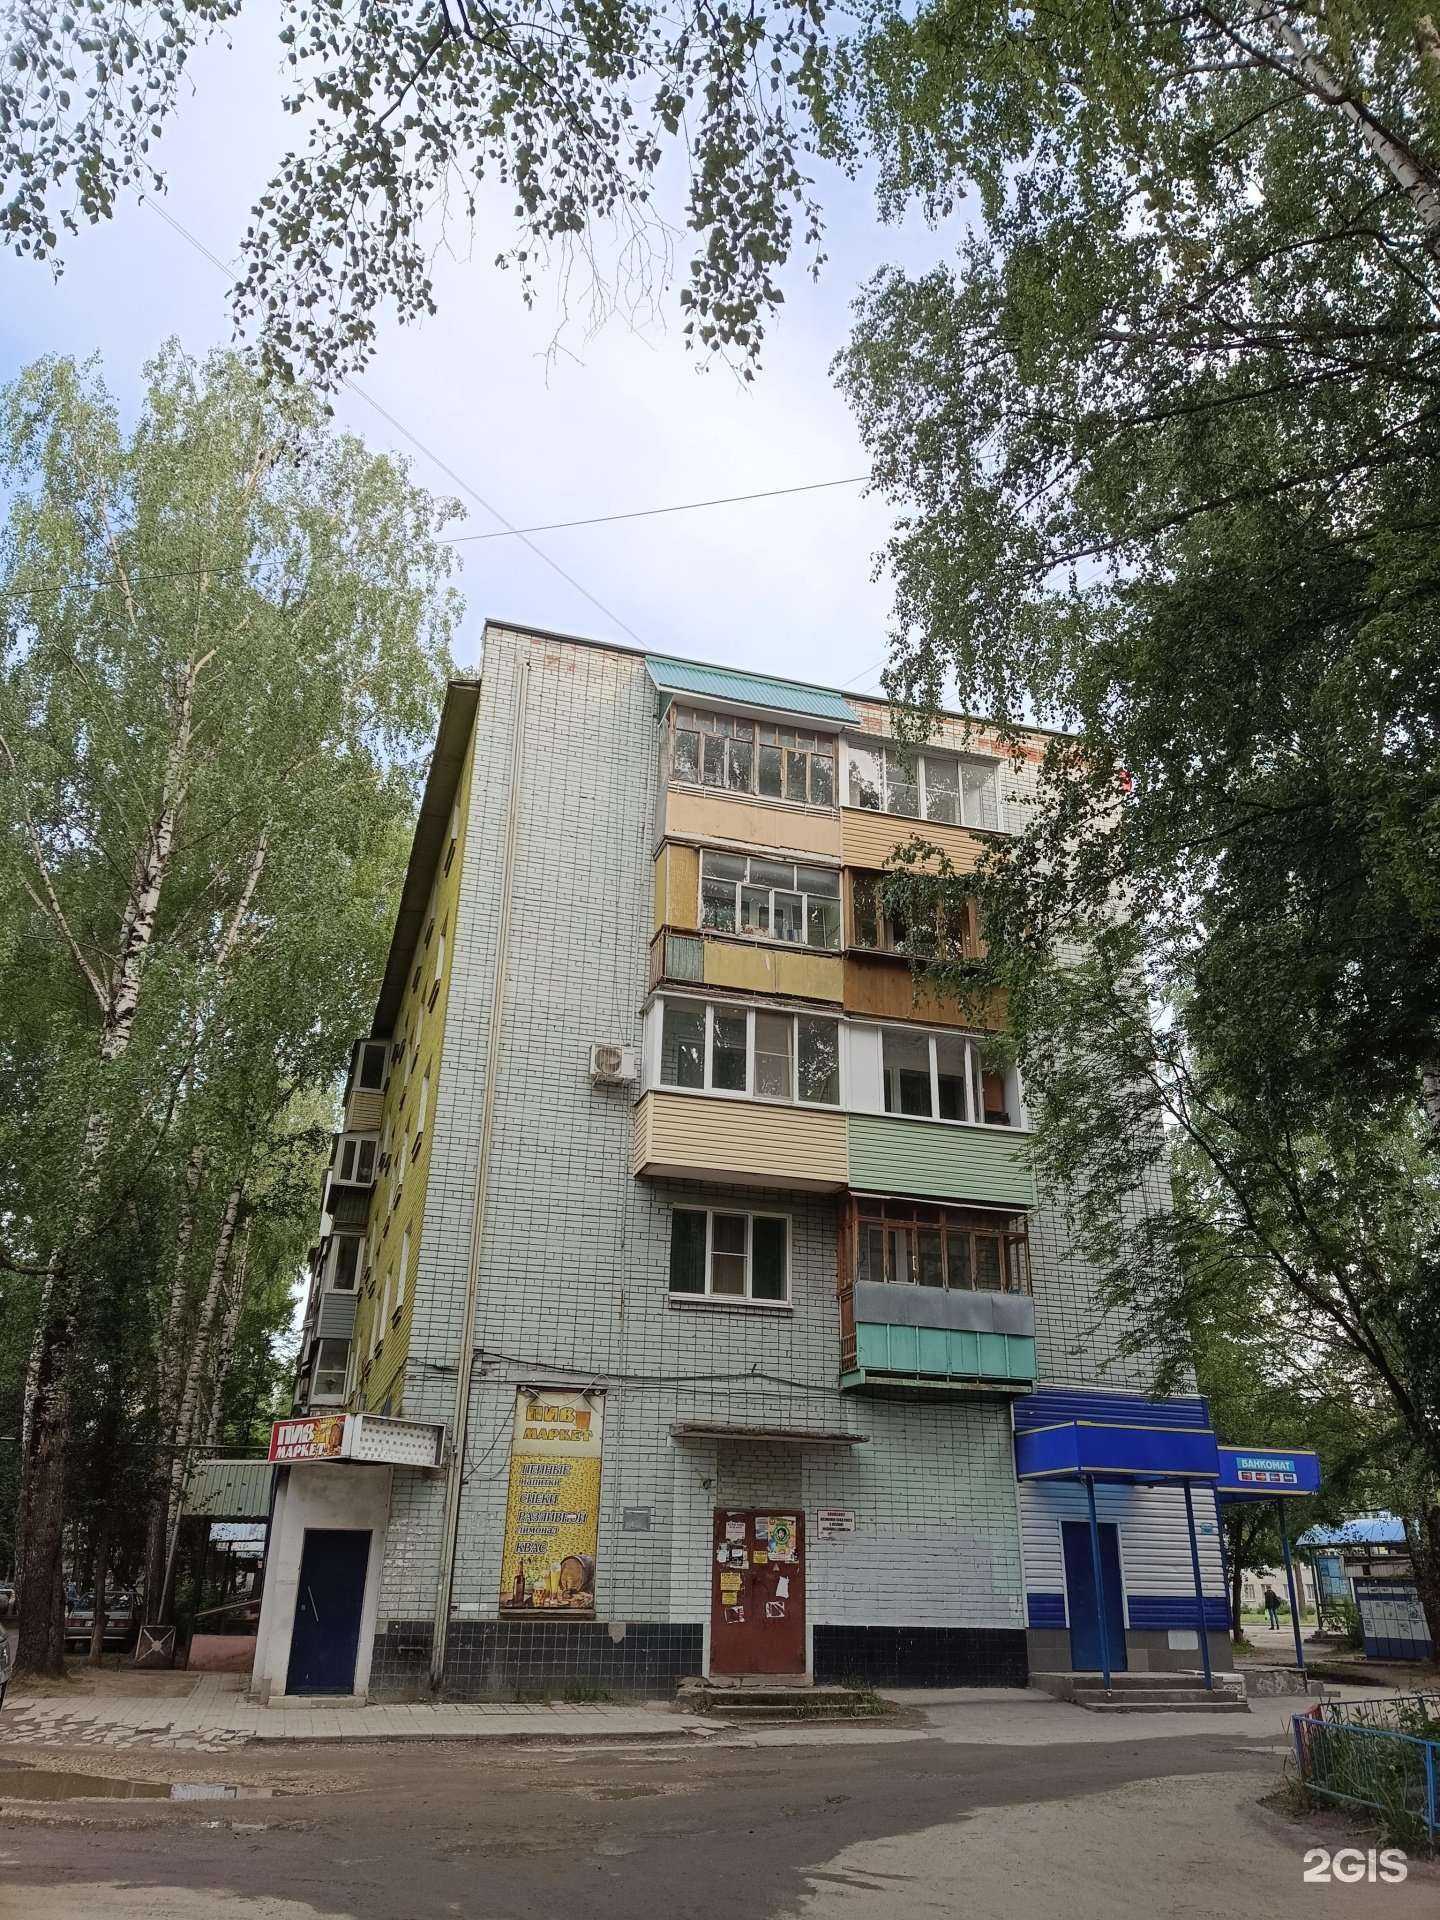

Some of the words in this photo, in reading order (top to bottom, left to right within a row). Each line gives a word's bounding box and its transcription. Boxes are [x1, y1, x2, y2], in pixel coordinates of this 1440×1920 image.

[523, 1427, 593, 1441] МАРКЕТ
[275, 1443, 326, 1459] МАРКЕТ
[521, 1463, 572, 1476] ПЕННЫЕ
[1241, 1459, 1290, 1470] БАНКОМАТ
[519, 1491, 559, 1504] СНЕКИ
[515, 1541, 548, 1554] КВАС
